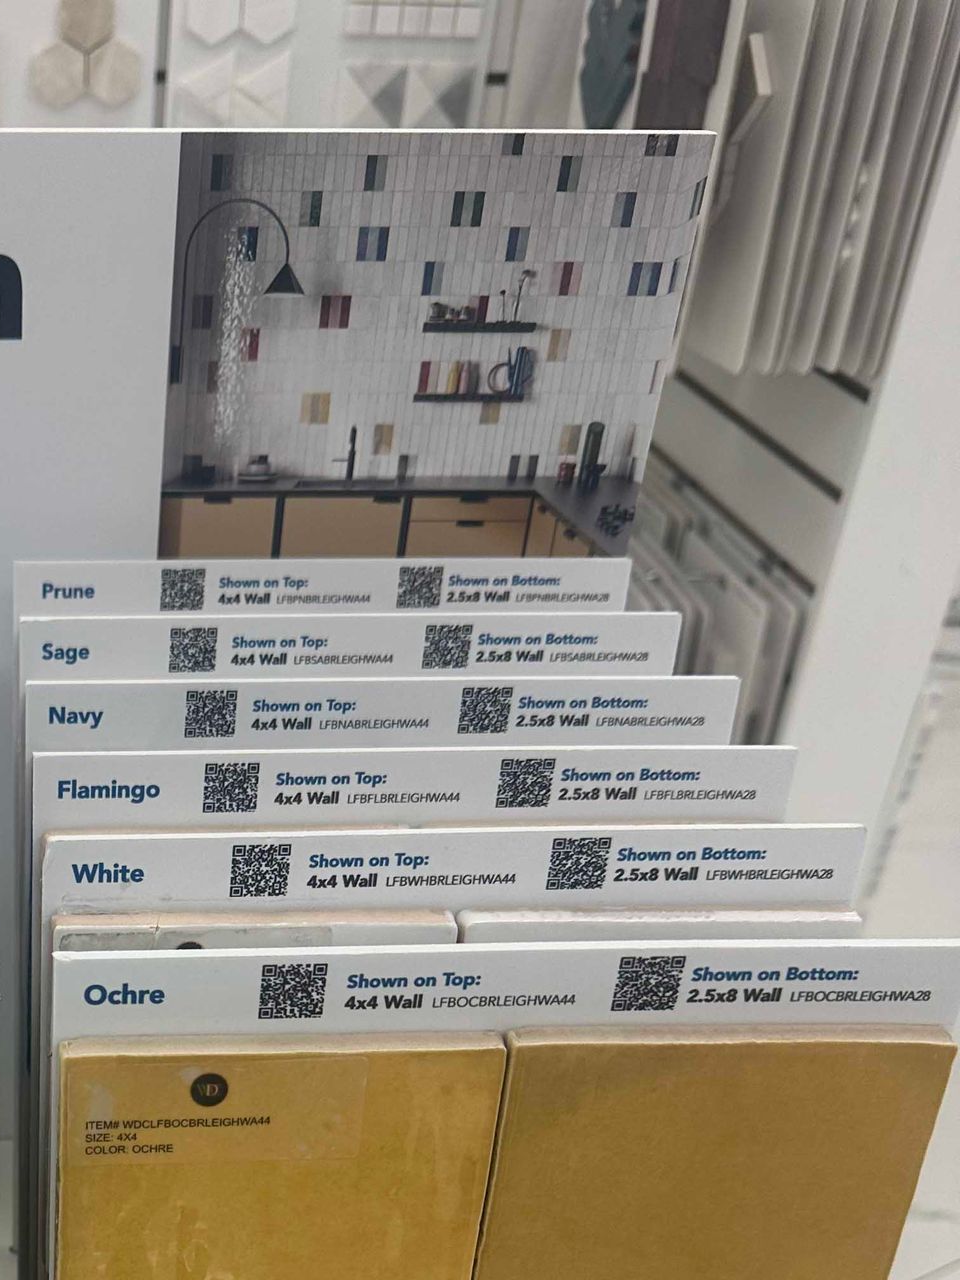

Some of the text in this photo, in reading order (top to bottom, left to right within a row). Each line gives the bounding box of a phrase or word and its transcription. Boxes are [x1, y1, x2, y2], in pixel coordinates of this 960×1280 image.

[219, 576, 308, 590] Shown on Top:
[449, 575, 560, 586] Shown on Bottom:
[43, 583, 95, 599] Prune
[447, 591, 510, 602] 2.5x8 Wall
[218, 593, 271, 604] 4x4 Wall
[232, 636, 328, 650] Shown on Top:
[478, 633, 598, 645] Shown on Bottom:
[42, 643, 89, 664] Sage
[231, 653, 287, 665] 4x4 Wall
[476, 650, 544, 662] 2.5x8 Wall
[253, 699, 356, 714] Shown on Top:
[518, 696, 648, 709] Shown on Bottom:
[49, 707, 103, 729] Navy
[251, 717, 429, 730] 4x4 Wall LFBNABRLEIGHWA44
[516, 715, 555, 727] 2.5x8
[560, 714, 589, 726] Wall
[276, 772, 387, 787] Shown on Top:
[561, 768, 700, 781] Shown on Bottom:
[58, 779, 160, 803] Flamingo
[274, 791, 460, 805] 4x4 Wall LFBFLBRLEIGHWA44
[558, 788, 600, 800] 2.5x8
[605, 787, 637, 800] Wall
[309, 853, 429, 869] Shown on Top:
[617, 847, 767, 861] Shown on Bottom:
[72, 862, 144, 883] White
[613, 867, 833, 881] 2.5x8 Wall LFBWHBRLEIGHWA28
[307, 873, 516, 888] 4x4 Wall LFBWHBRLEIGHWA44
[347, 972, 481, 990] Shown on Top:
[691, 967, 859, 981] Shown on Bottom:
[84, 983, 165, 1005] Ochre
[686, 988, 931, 1003] 2.5x8 Wall LFBOCBRLEIGHWA28
[344, 994, 575, 1010] 4x4 Wall LFBOCBRLEIGHWA44
[86, 1116, 270, 1130] ITEM# WDCLFBOCBRLEIGHWA44
[85, 1133, 137, 1143] SIZE: 4X4
[85, 1144, 173, 1155] COLOR: OCHRE
